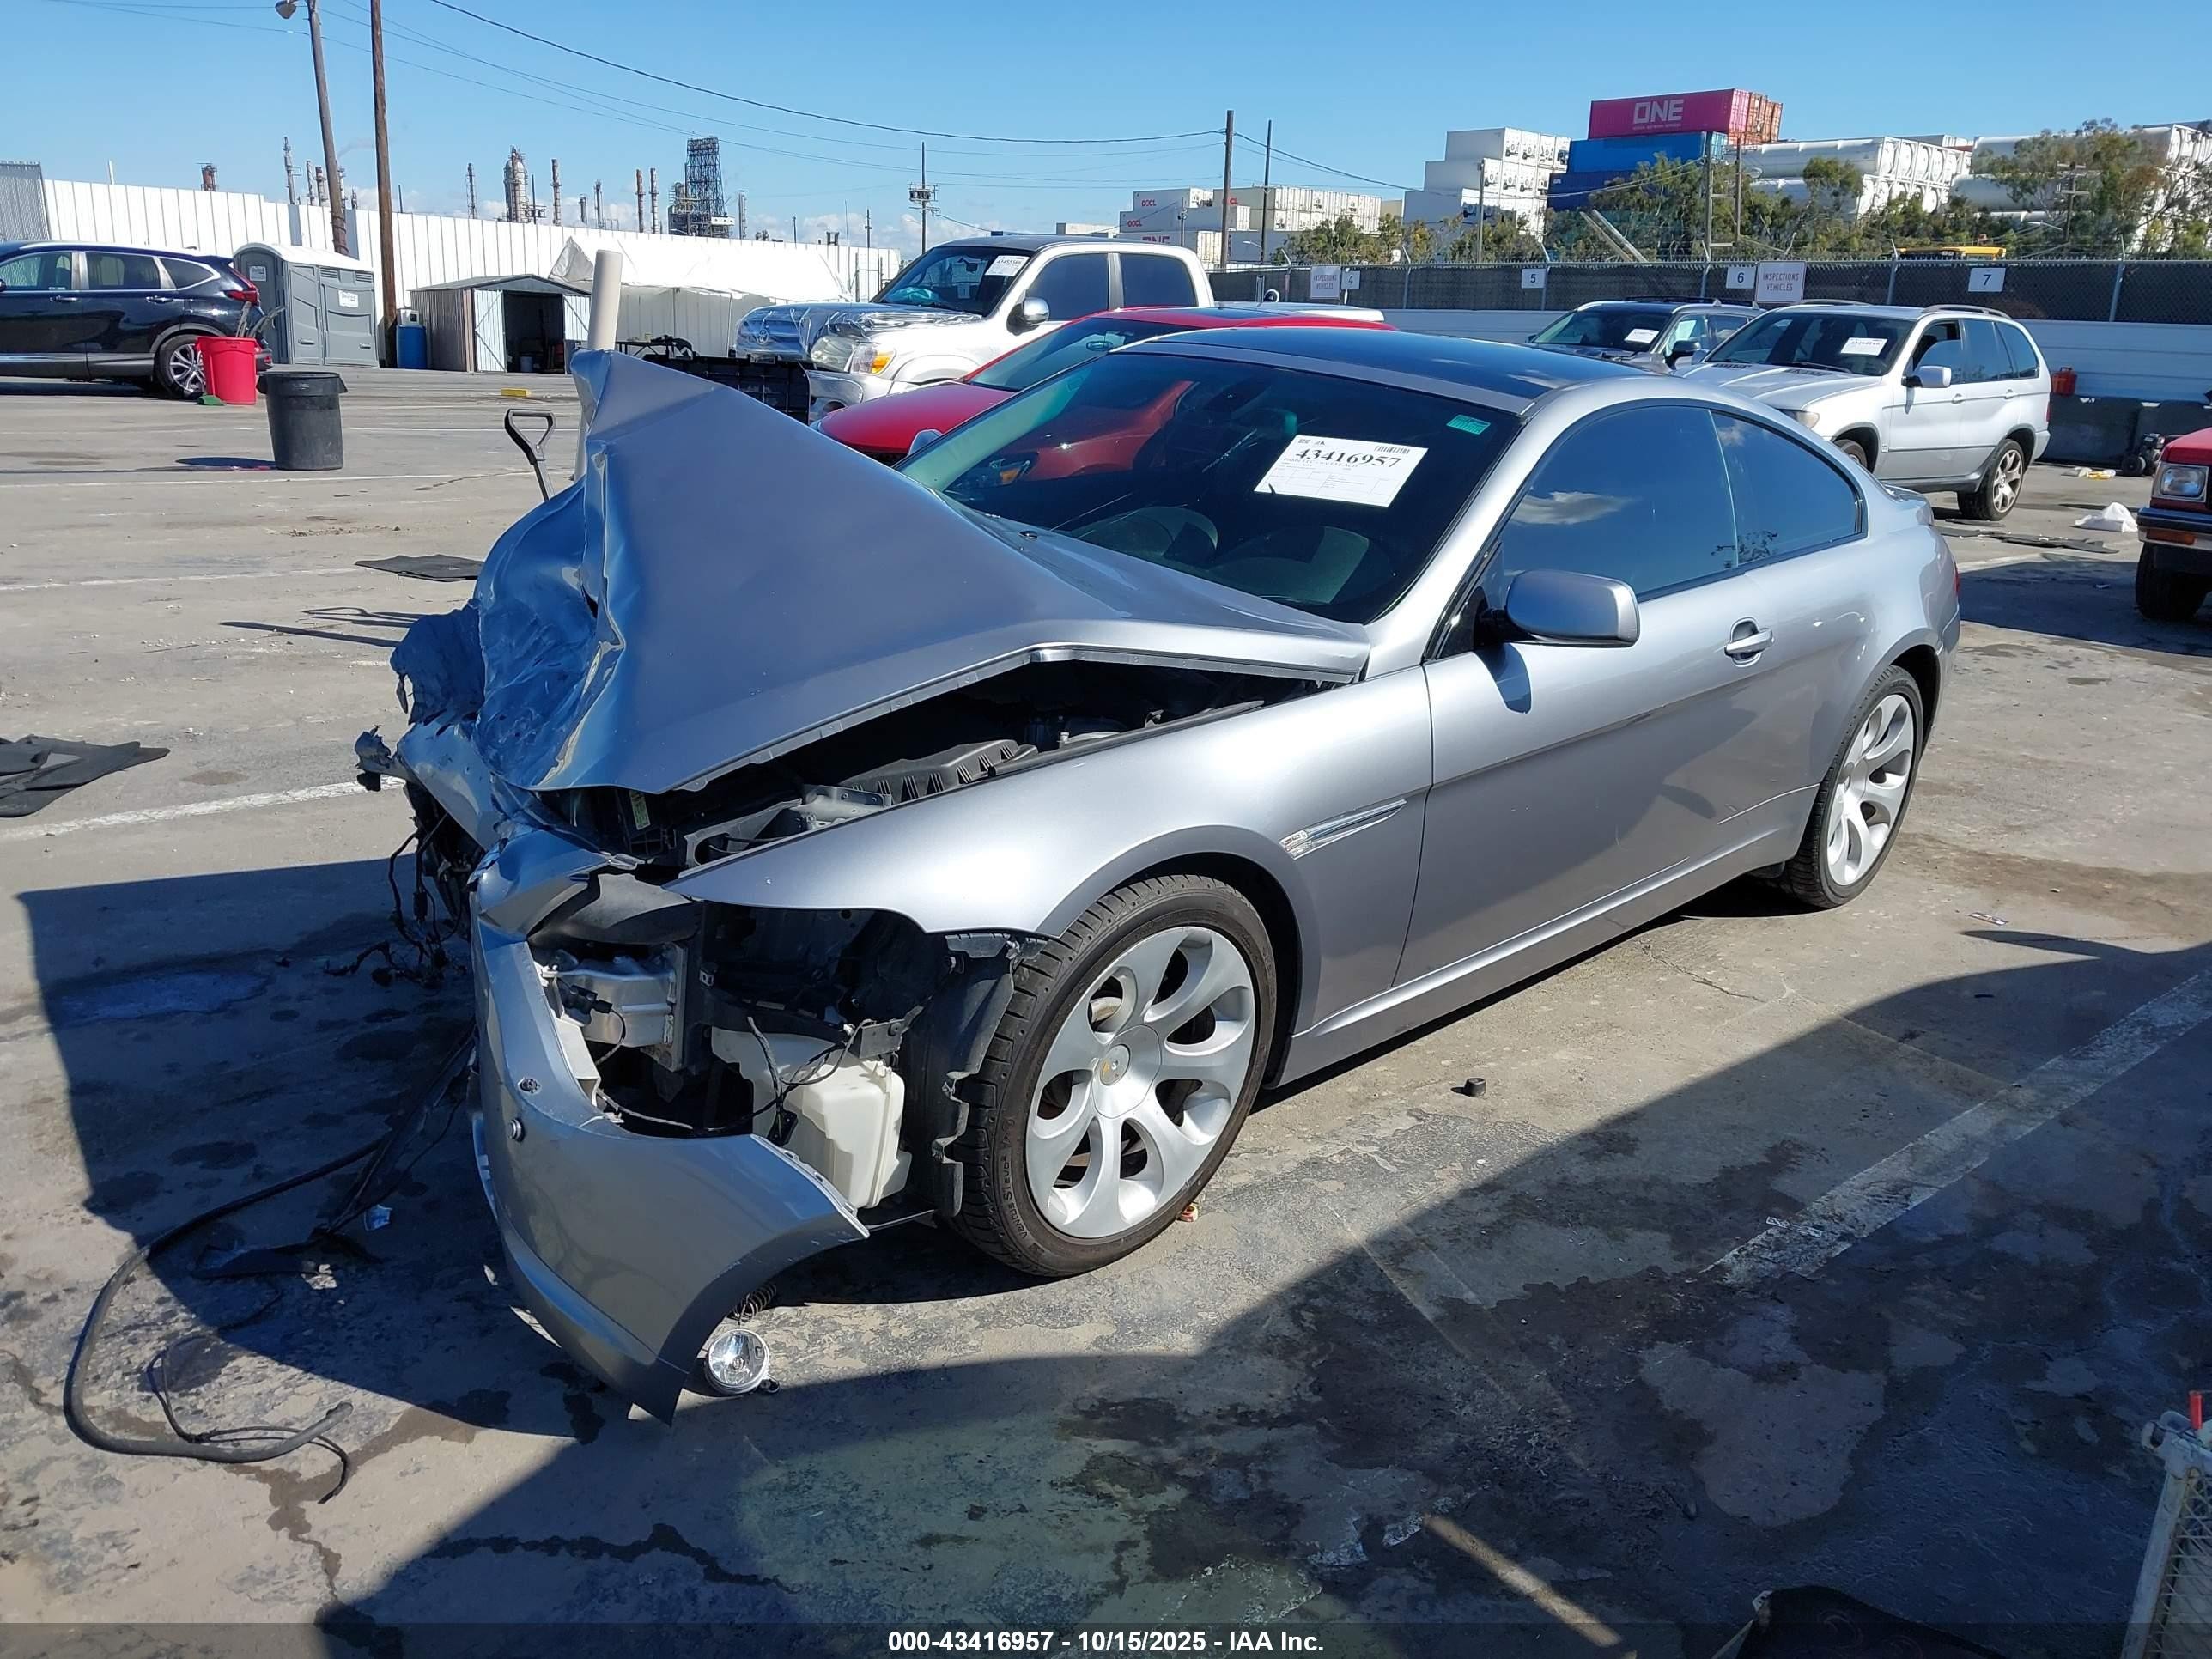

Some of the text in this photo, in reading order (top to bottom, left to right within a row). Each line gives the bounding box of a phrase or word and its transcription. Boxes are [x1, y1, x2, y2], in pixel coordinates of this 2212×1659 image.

[1633, 100, 1685, 124] ONE
[1348, 274, 1354, 283] 4
[1530, 273, 1537, 283] 5
[1737, 272, 1745, 283] 6
[1763, 272, 1800, 282] INSPECTIONS
[1983, 274, 1992, 286] 7
[1766, 283, 1793, 292] VEHICLES
[1295, 448, 1402, 468] 43416957
